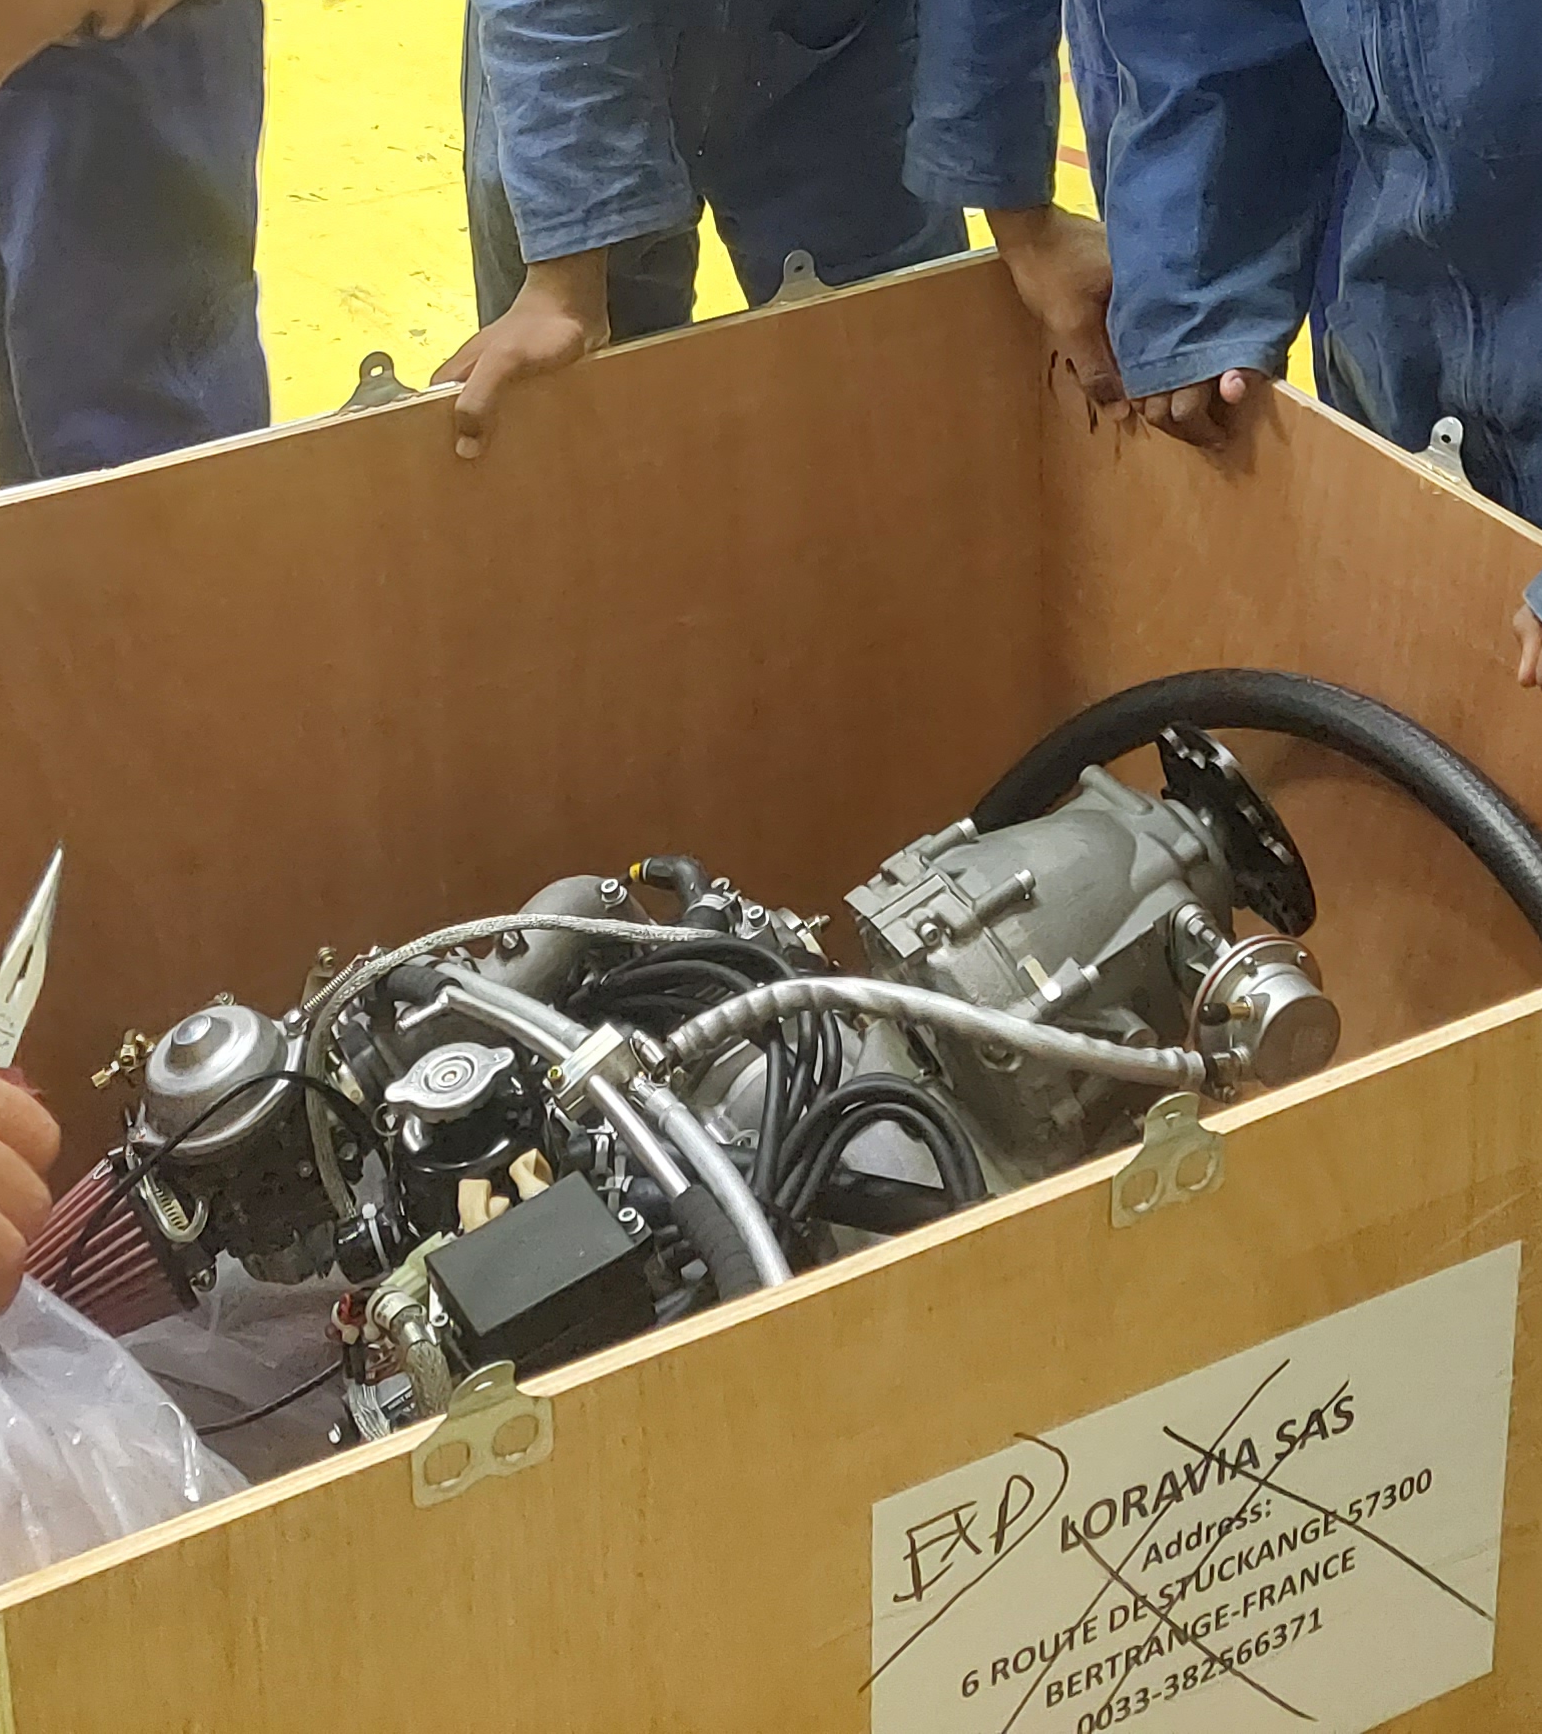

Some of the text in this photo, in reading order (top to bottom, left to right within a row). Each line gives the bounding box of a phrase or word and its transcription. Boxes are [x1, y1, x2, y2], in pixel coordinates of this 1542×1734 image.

[1061, 1395, 1355, 1553] LORAVIA SAS
[1141, 1498, 1272, 1573] Address:
[961, 1468, 1433, 1699] 6 ROUTE DE STUCKANGE 57300
[1045, 1546, 1357, 1708] BERTRANGE-FRANCE
